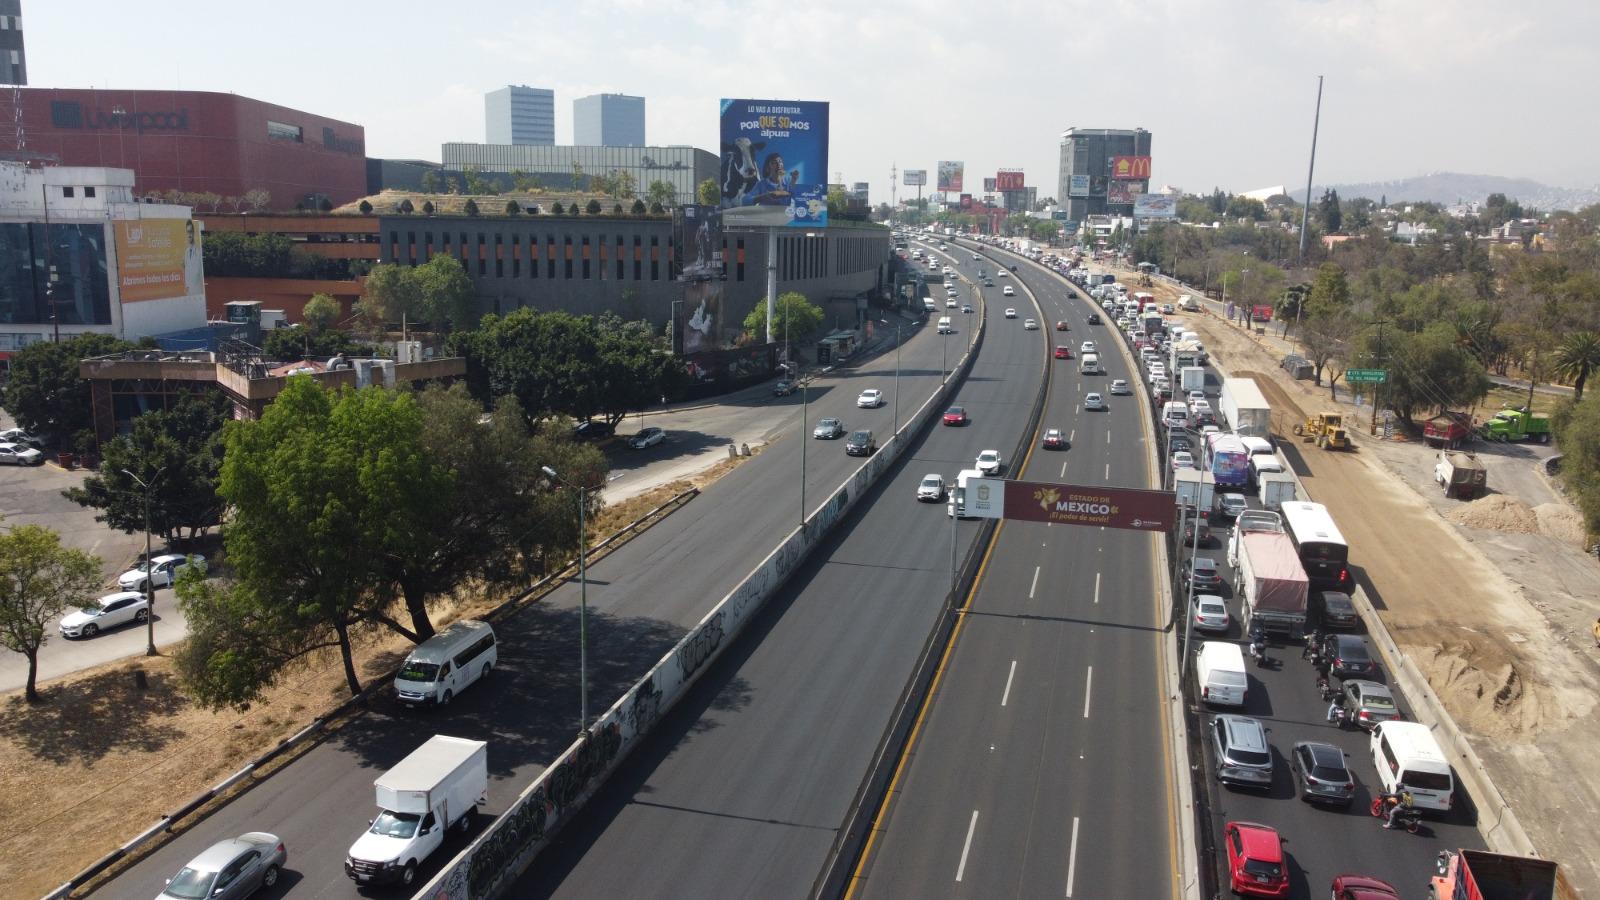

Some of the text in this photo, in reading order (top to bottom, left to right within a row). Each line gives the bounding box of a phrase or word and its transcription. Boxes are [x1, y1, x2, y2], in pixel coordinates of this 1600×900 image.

[747, 105, 755, 113] LO
[755, 105, 766, 113] VAS
[85, 105, 189, 135] Liverpool
[740, 115, 810, 130] PORQUE SOMOS
[760, 128, 790, 139] alpura
[1069, 494, 1098, 503] ESTADO
[1059, 512, 1078, 522] poder
[1079, 513, 1087, 521] de
[1088, 514, 1110, 523] servir!
